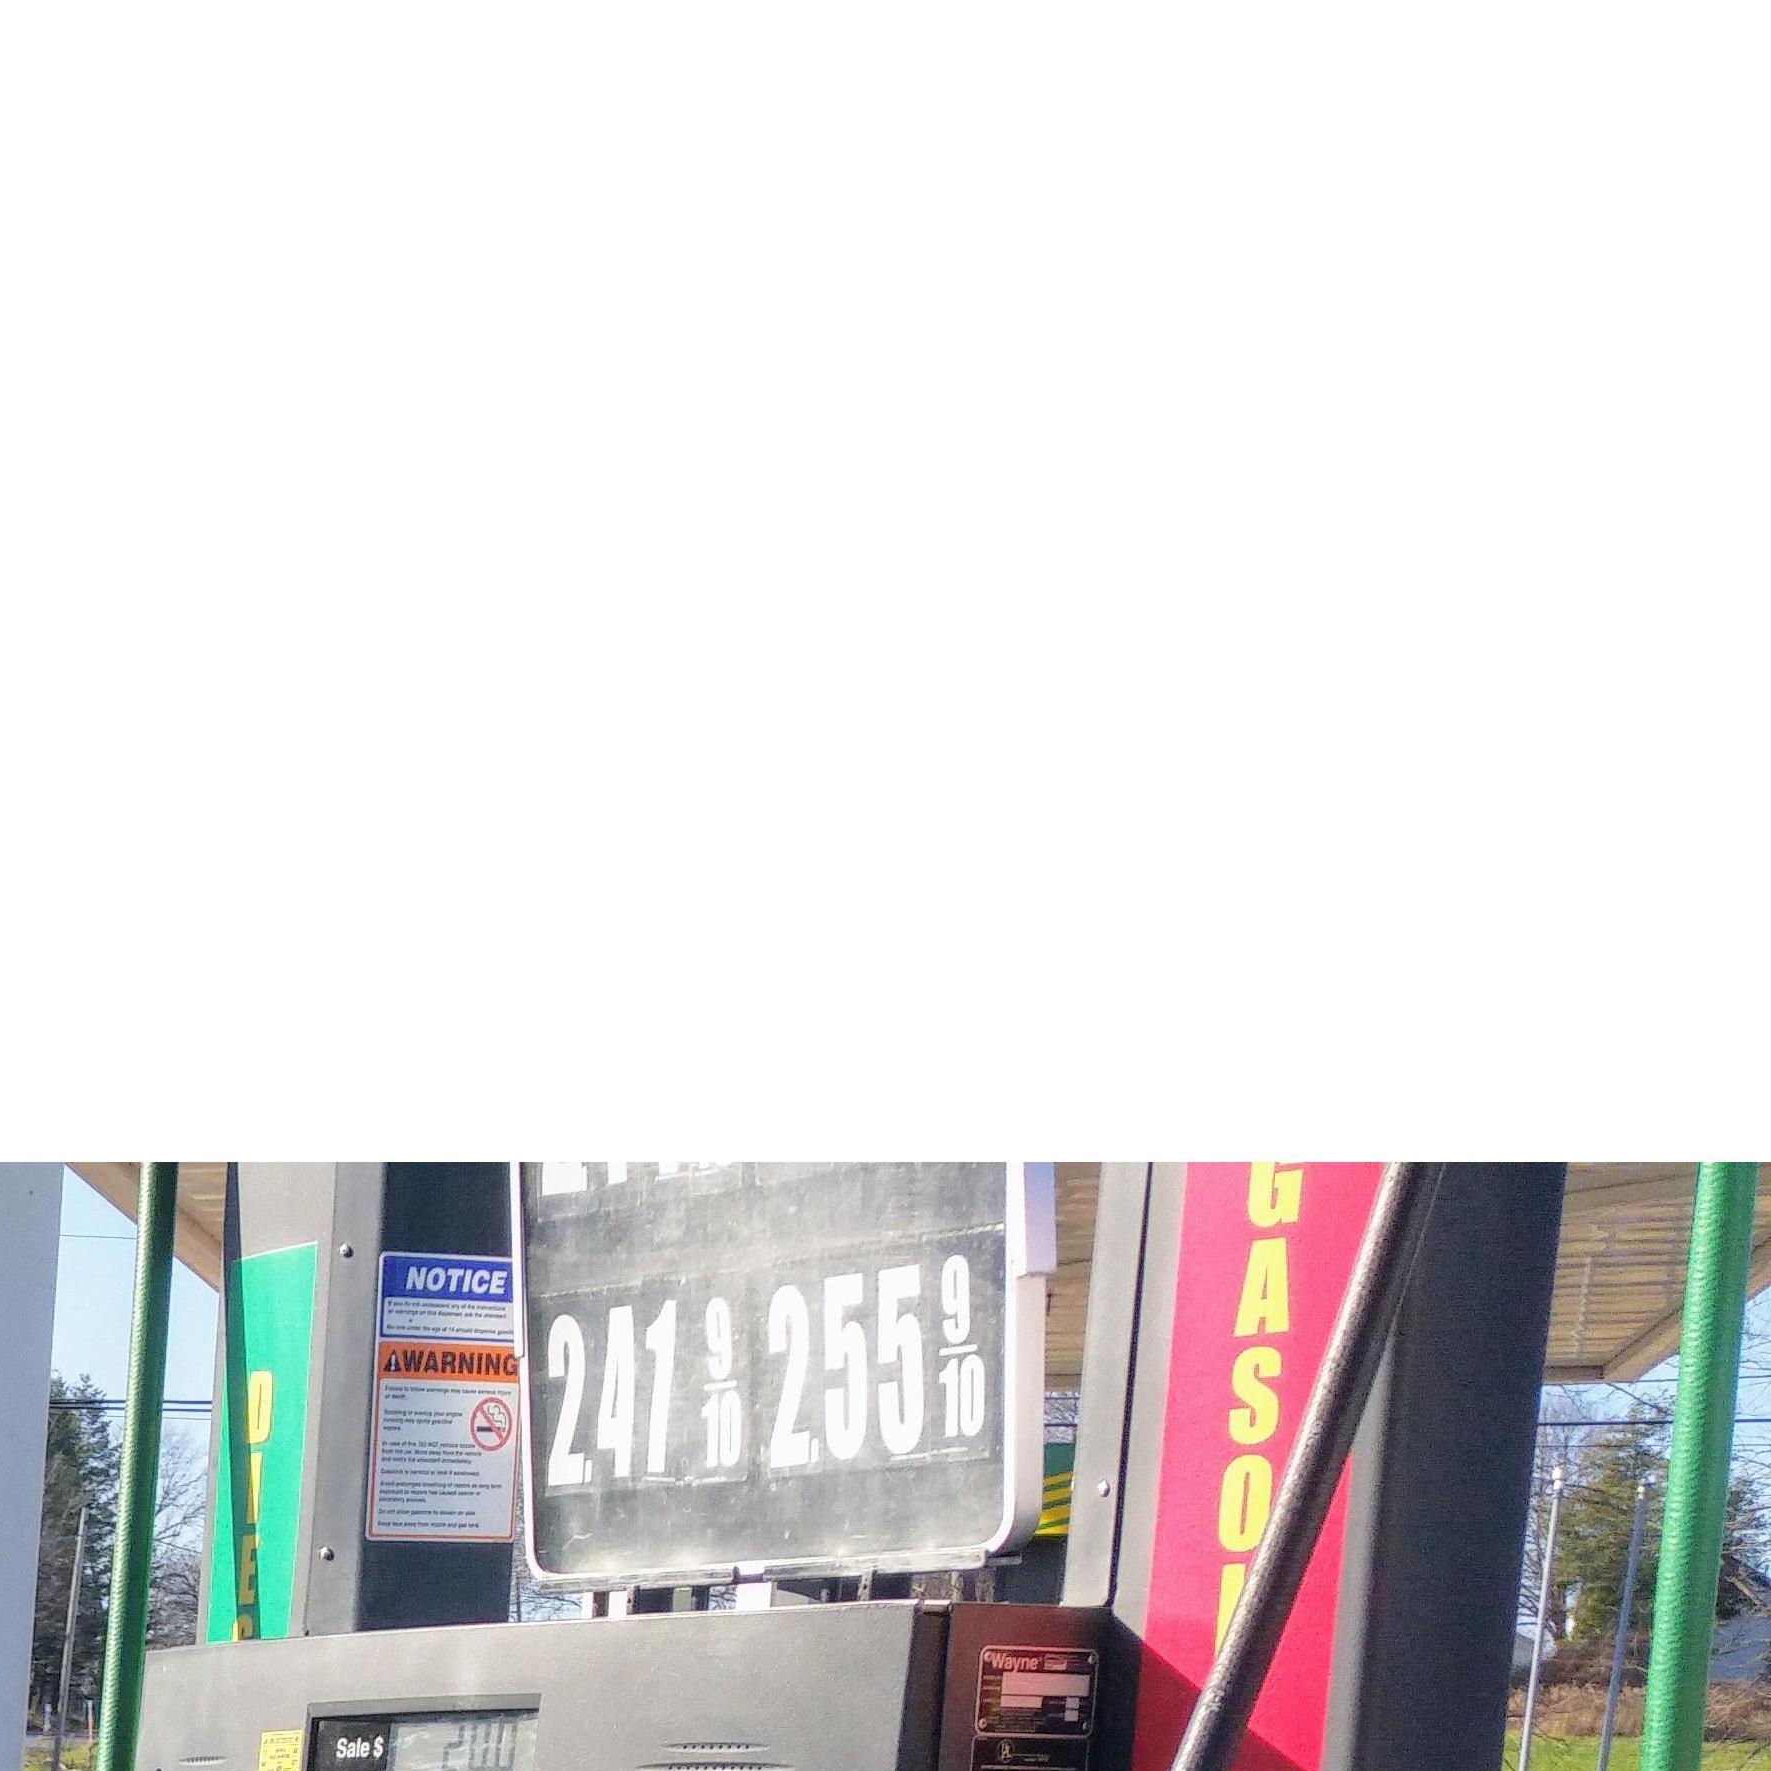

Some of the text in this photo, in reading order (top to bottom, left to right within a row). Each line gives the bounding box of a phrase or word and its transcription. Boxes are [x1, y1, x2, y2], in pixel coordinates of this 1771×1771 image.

[406, 1266, 508, 1295] NOTICE
[403, 1350, 518, 1376] WARNING
[336, 1734, 385, 1759] Sale $
